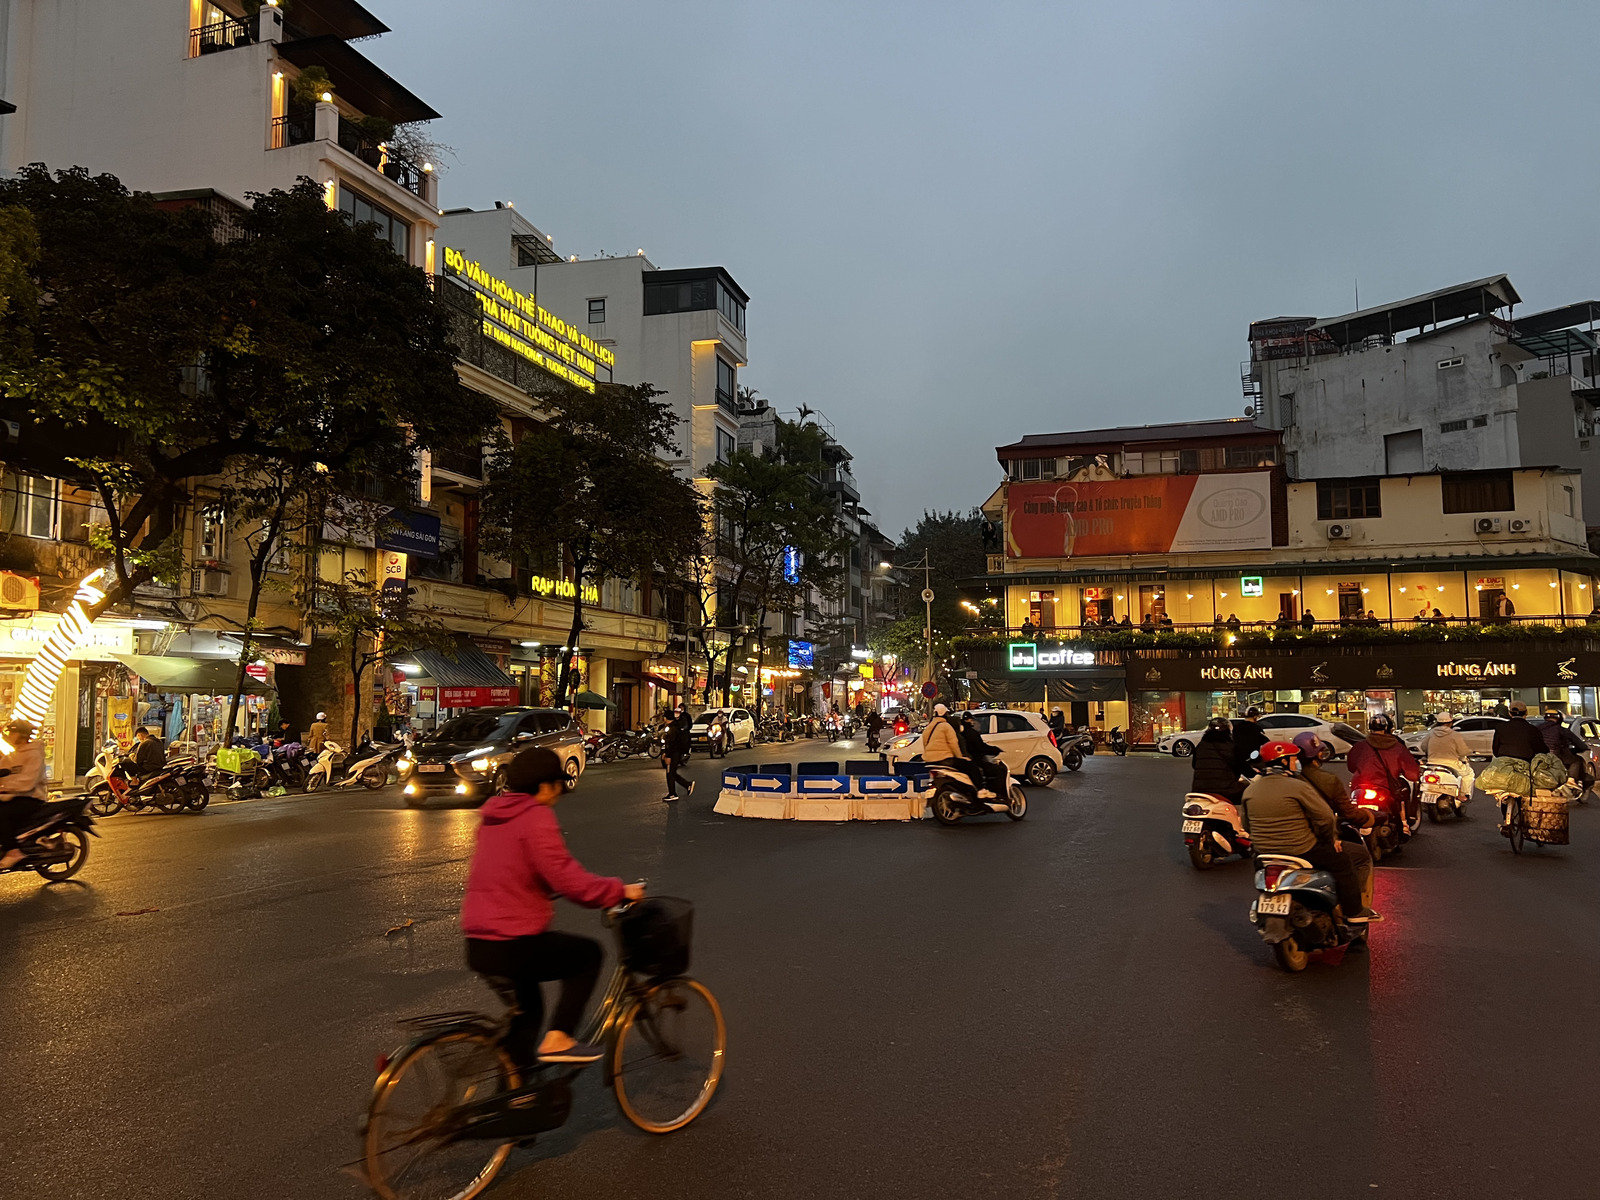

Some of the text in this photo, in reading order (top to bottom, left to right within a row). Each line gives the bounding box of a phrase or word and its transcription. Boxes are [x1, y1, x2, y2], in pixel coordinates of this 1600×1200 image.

[445, 247, 464, 275] BỘ
[465, 259, 490, 288] VĂN
[537, 305, 565, 335] THAO
[566, 324, 579, 345] VÀ
[580, 333, 594, 353] DU
[493, 327, 511, 348] NAM
[511, 337, 545, 366] NATIONAL
[576, 352, 595, 375] NAM
[385, 565, 402, 574] SCB
[531, 575, 554, 596] RẠP
[585, 584, 599, 602] HÀ
[1013, 649, 1095, 665] aha coffee
[1201, 664, 1273, 680] HÙNG ÁNH
[1437, 661, 1516, 676] HÙNG ÁNH
